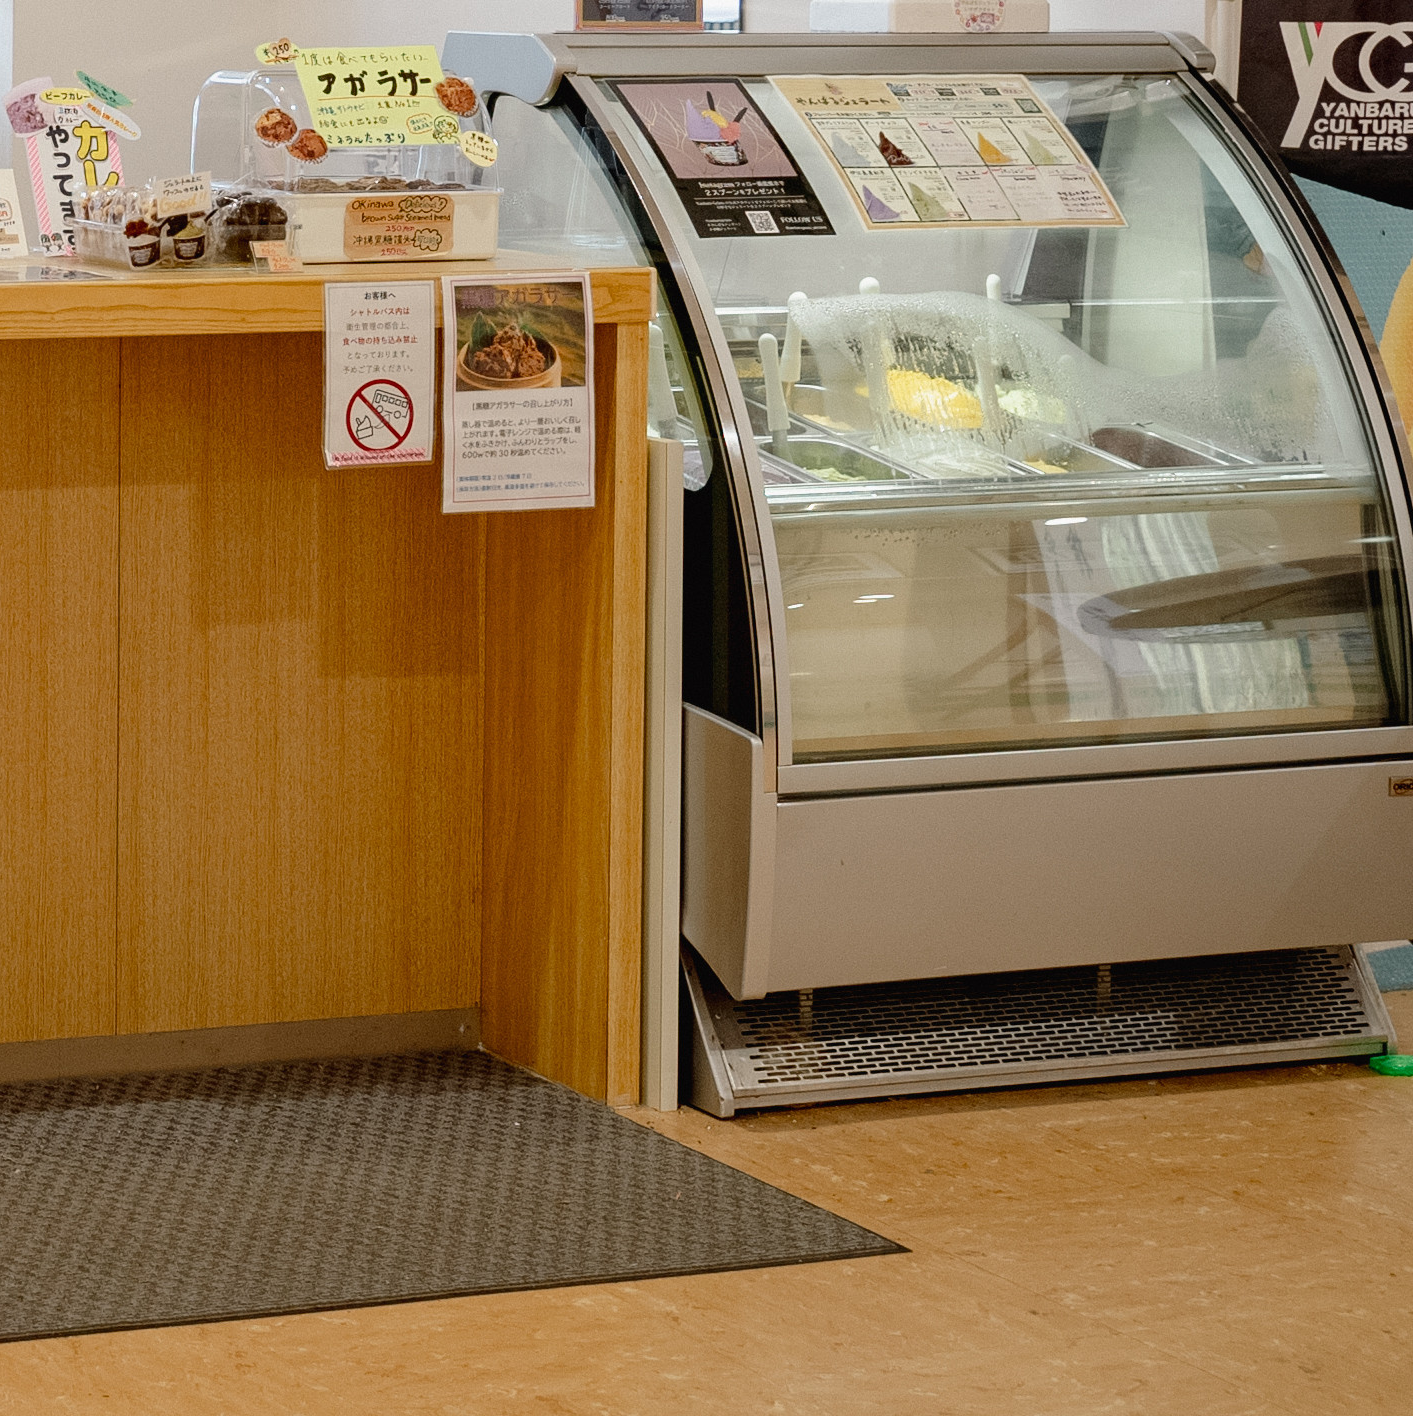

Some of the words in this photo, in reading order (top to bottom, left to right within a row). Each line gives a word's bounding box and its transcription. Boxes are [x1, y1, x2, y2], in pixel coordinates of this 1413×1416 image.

[318, 69, 432, 96] アガラサー
[45, 92, 90, 100] ビーフカレー
[1321, 102, 1413, 118] YANBAR
[1314, 119, 1413, 134] CULTURE
[1309, 135, 1408, 151] GIFTERS
[362, 212, 386, 222] brown
[364, 291, 396, 300] お客様へ
[350, 307, 410, 316] シャトルバス内は
[346, 322, 409, 331] 衛生管理の都合上、
[343, 335, 418, 346] 食べ物の持ち込み禁止
[347, 350, 410, 359] となっております。
[343, 365, 413, 374] 予めご了承ください。
